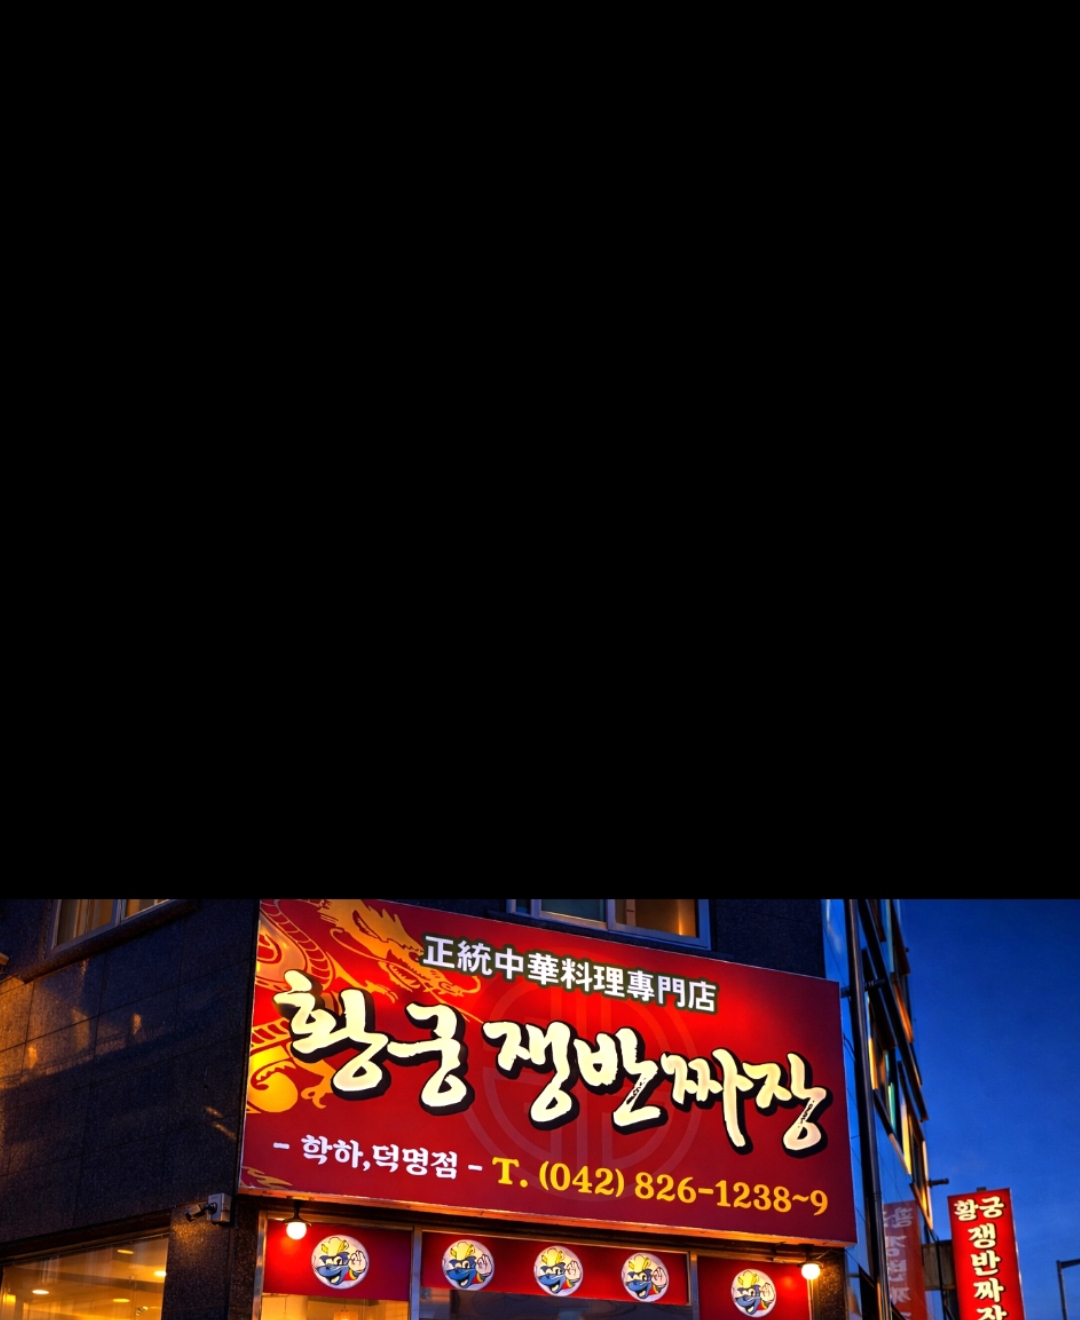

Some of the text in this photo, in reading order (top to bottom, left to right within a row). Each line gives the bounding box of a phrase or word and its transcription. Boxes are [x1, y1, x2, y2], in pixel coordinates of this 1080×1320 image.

[423, 935, 717, 1012] 正統中華料理專門店
[273, 970, 828, 1152] 황궁 쟁반짜장
[301, 1134, 458, 1179] 학하,덕명점
[492, 1157, 828, 1216] T. (042) 826-1238~9
[954, 1196, 1005, 1221] 황궁
